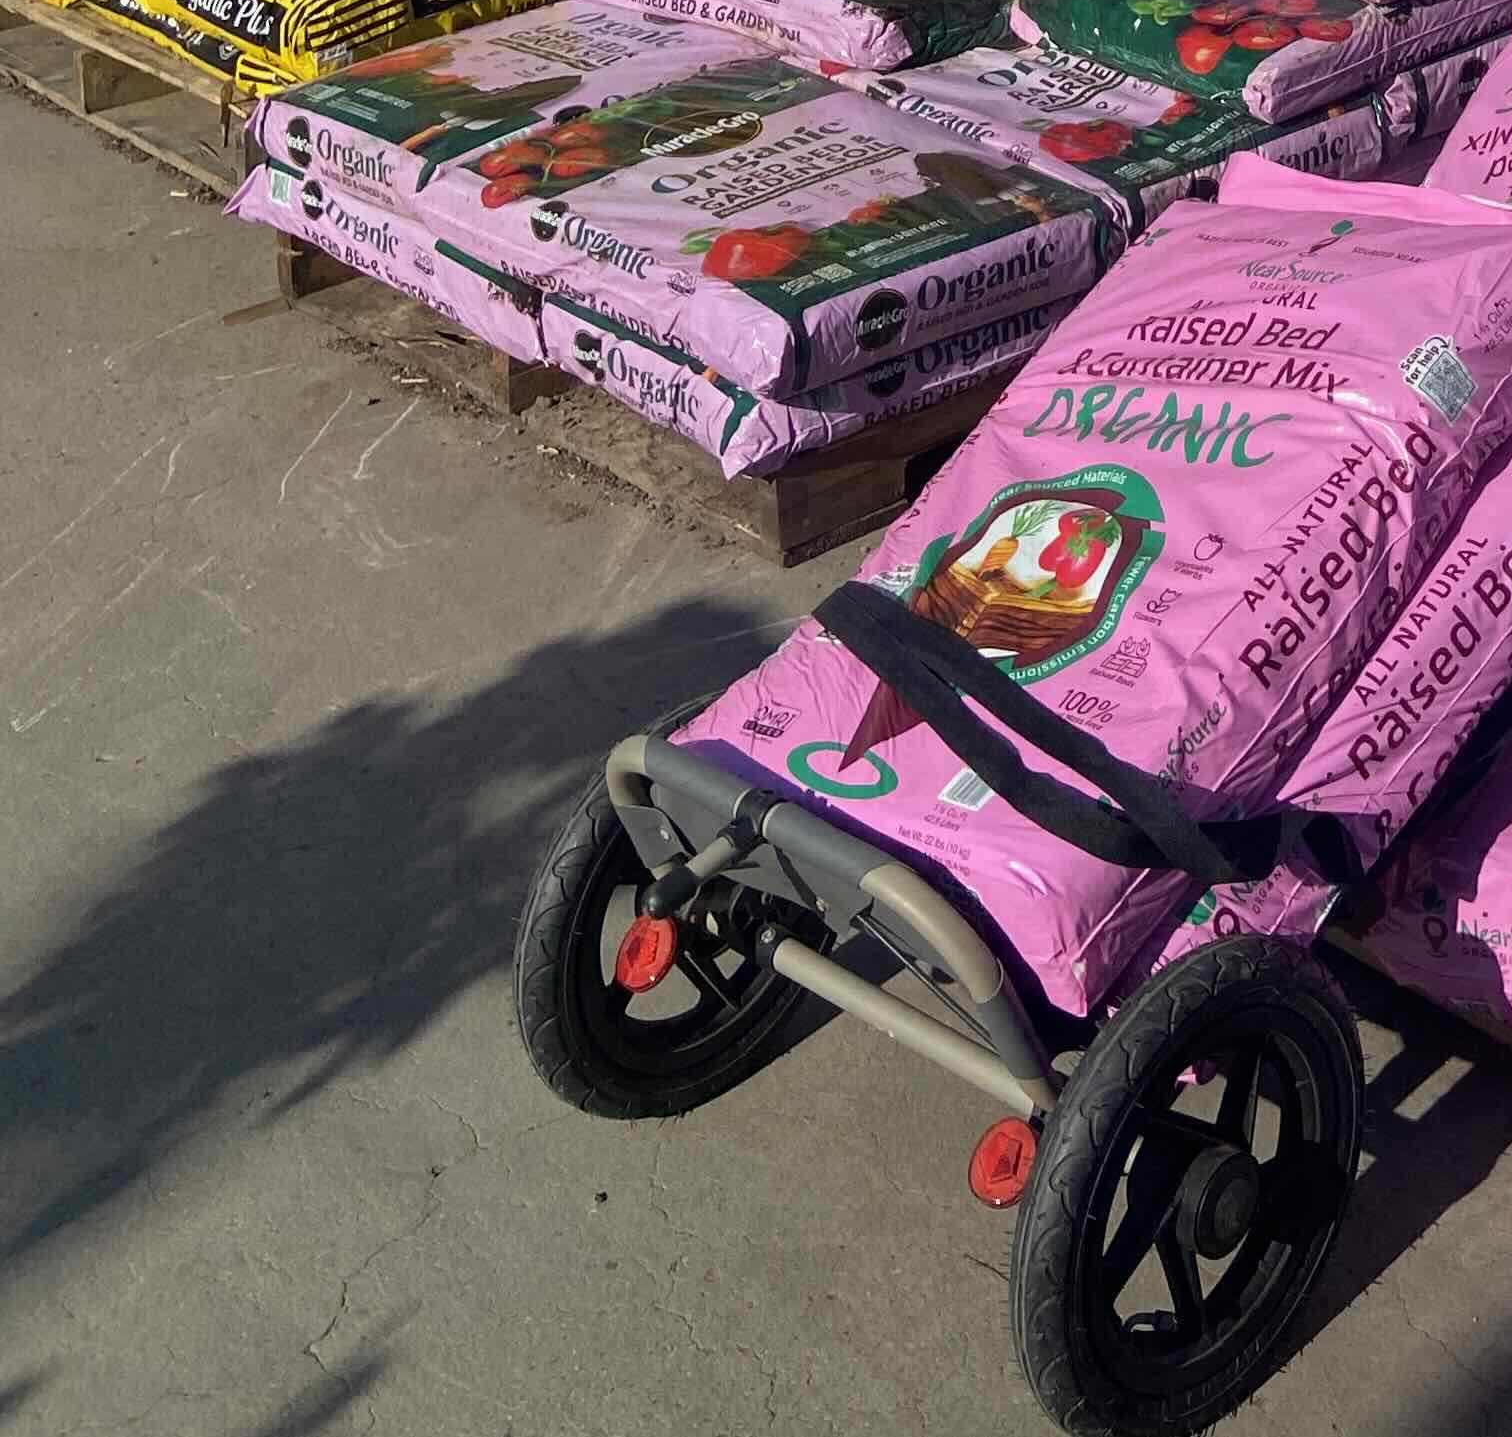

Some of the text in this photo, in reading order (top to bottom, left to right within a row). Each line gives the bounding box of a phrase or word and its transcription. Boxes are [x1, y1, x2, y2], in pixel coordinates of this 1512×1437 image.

[316, 128, 394, 188] Organic
[651, 118, 849, 194] Organic
[681, 143, 847, 205] RAISED BED
[700, 141, 897, 211] GARDEN SOIL
[917, 238, 1058, 311] Organic
[1239, 260, 1345, 284] NearSource
[1401, 346, 1423, 372] Scan
[1023, 384, 1294, 468] ORGANIC
[1082, 469, 1127, 485] Materials
[1120, 556, 1152, 589] Fewer
[1087, 594, 1125, 645] Carbon
[1008, 642, 1087, 681] Emissions
[1058, 689, 1120, 724] 100%
[1347, 605, 1481, 781] Raised
